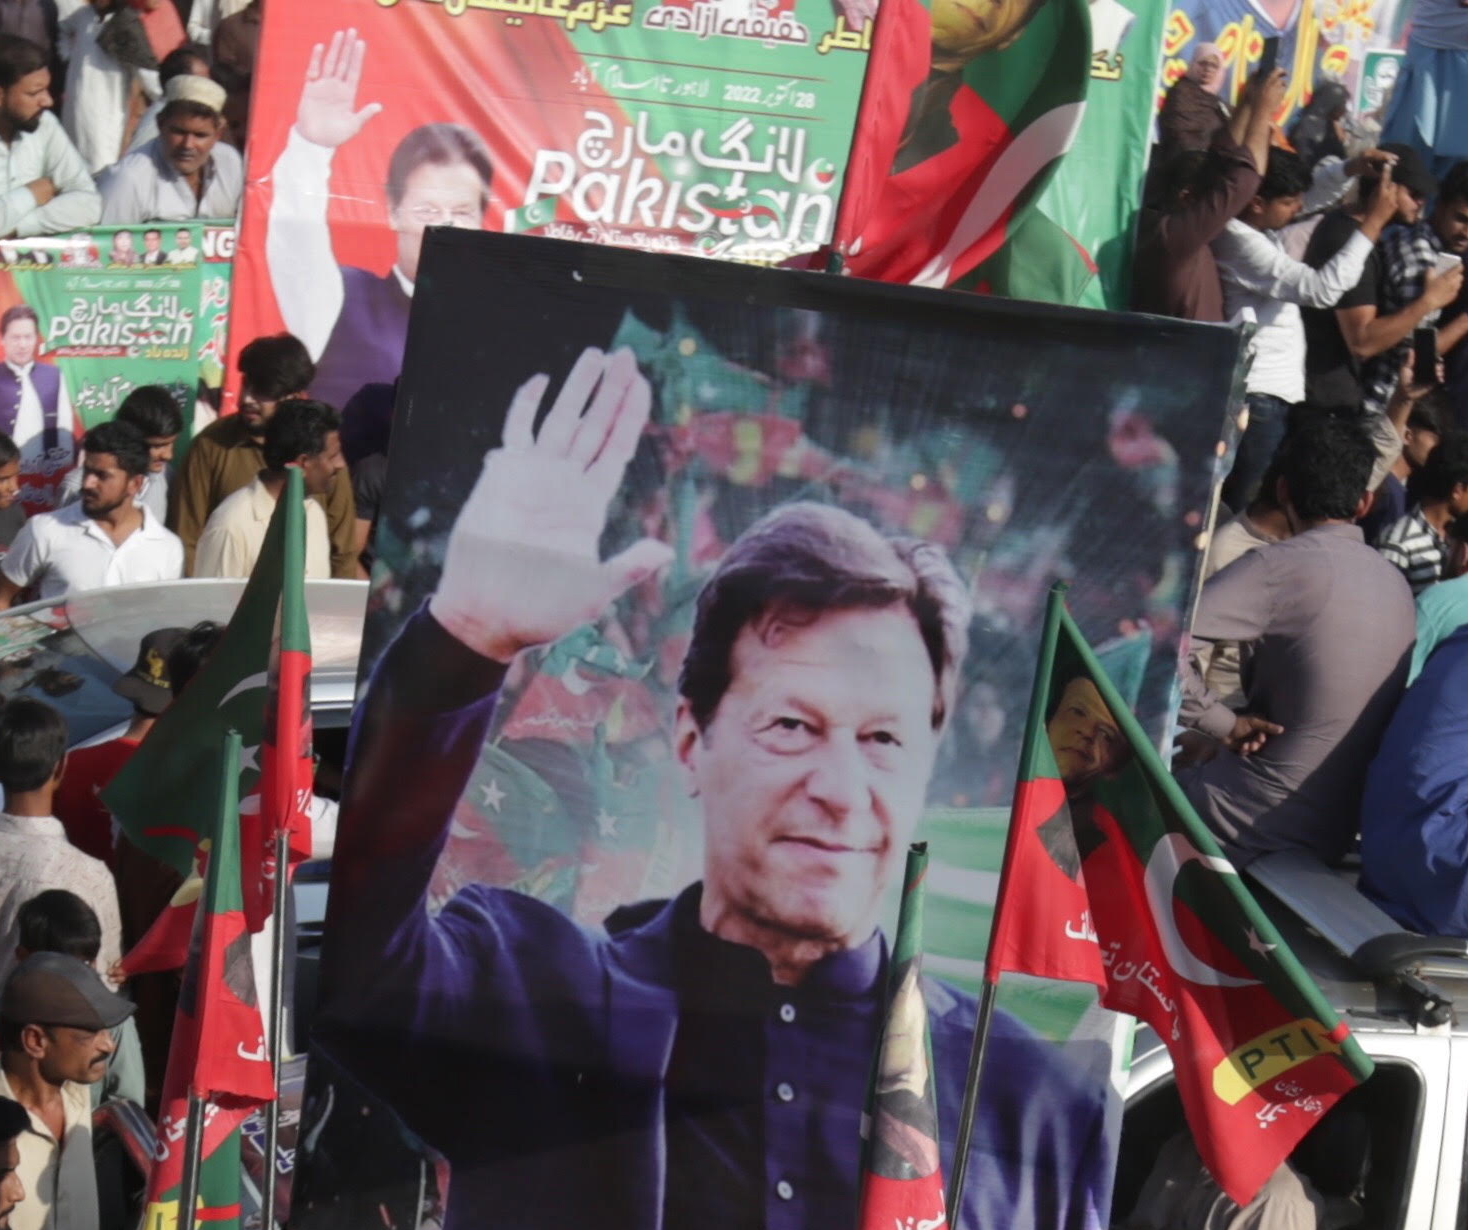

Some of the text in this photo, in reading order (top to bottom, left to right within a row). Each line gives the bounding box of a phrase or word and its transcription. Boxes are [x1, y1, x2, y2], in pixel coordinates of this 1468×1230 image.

[816, 15, 872, 54] اطر
[723, 84, 761, 104] 2022
[796, 91, 816, 109] 28
[578, 110, 807, 184] لانگ مارچ
[523, 149, 834, 246] Pakistan
[202, 229, 236, 258] NG
[48, 314, 195, 347] Pakistan
[1238, 1026, 1321, 1081] PTI
